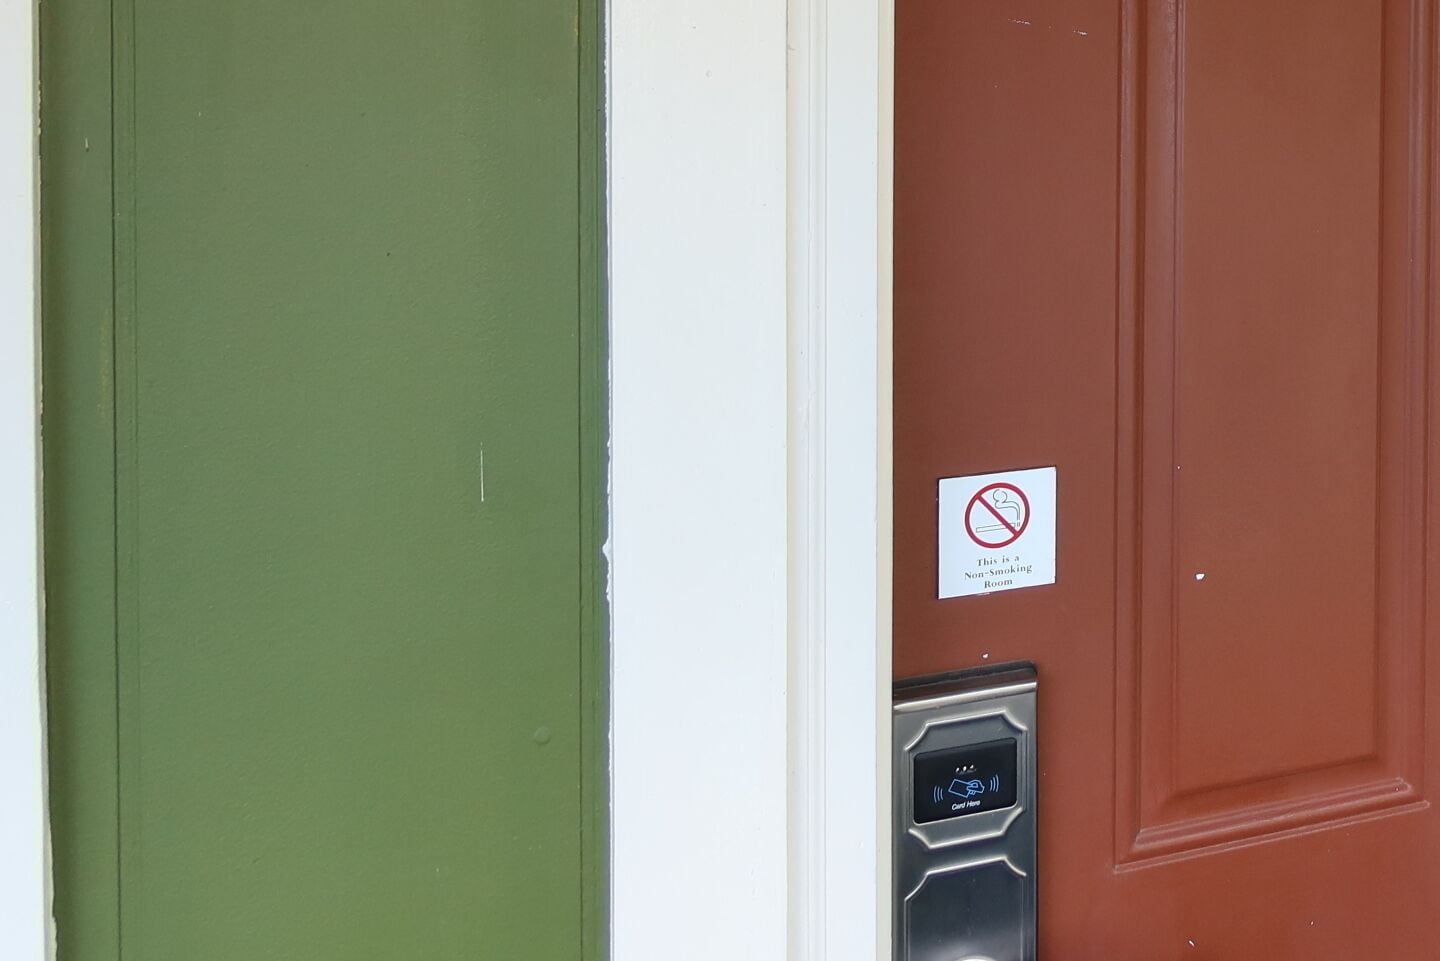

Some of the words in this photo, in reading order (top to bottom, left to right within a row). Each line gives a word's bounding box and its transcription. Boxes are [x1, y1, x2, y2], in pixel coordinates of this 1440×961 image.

[976, 557, 998, 567] This
[1002, 555, 1010, 563] is
[964, 564, 1033, 580] Non-Smoking
[984, 579, 1013, 589] Room
[951, 802, 966, 811] Card
[967, 800, 981, 808] Here
